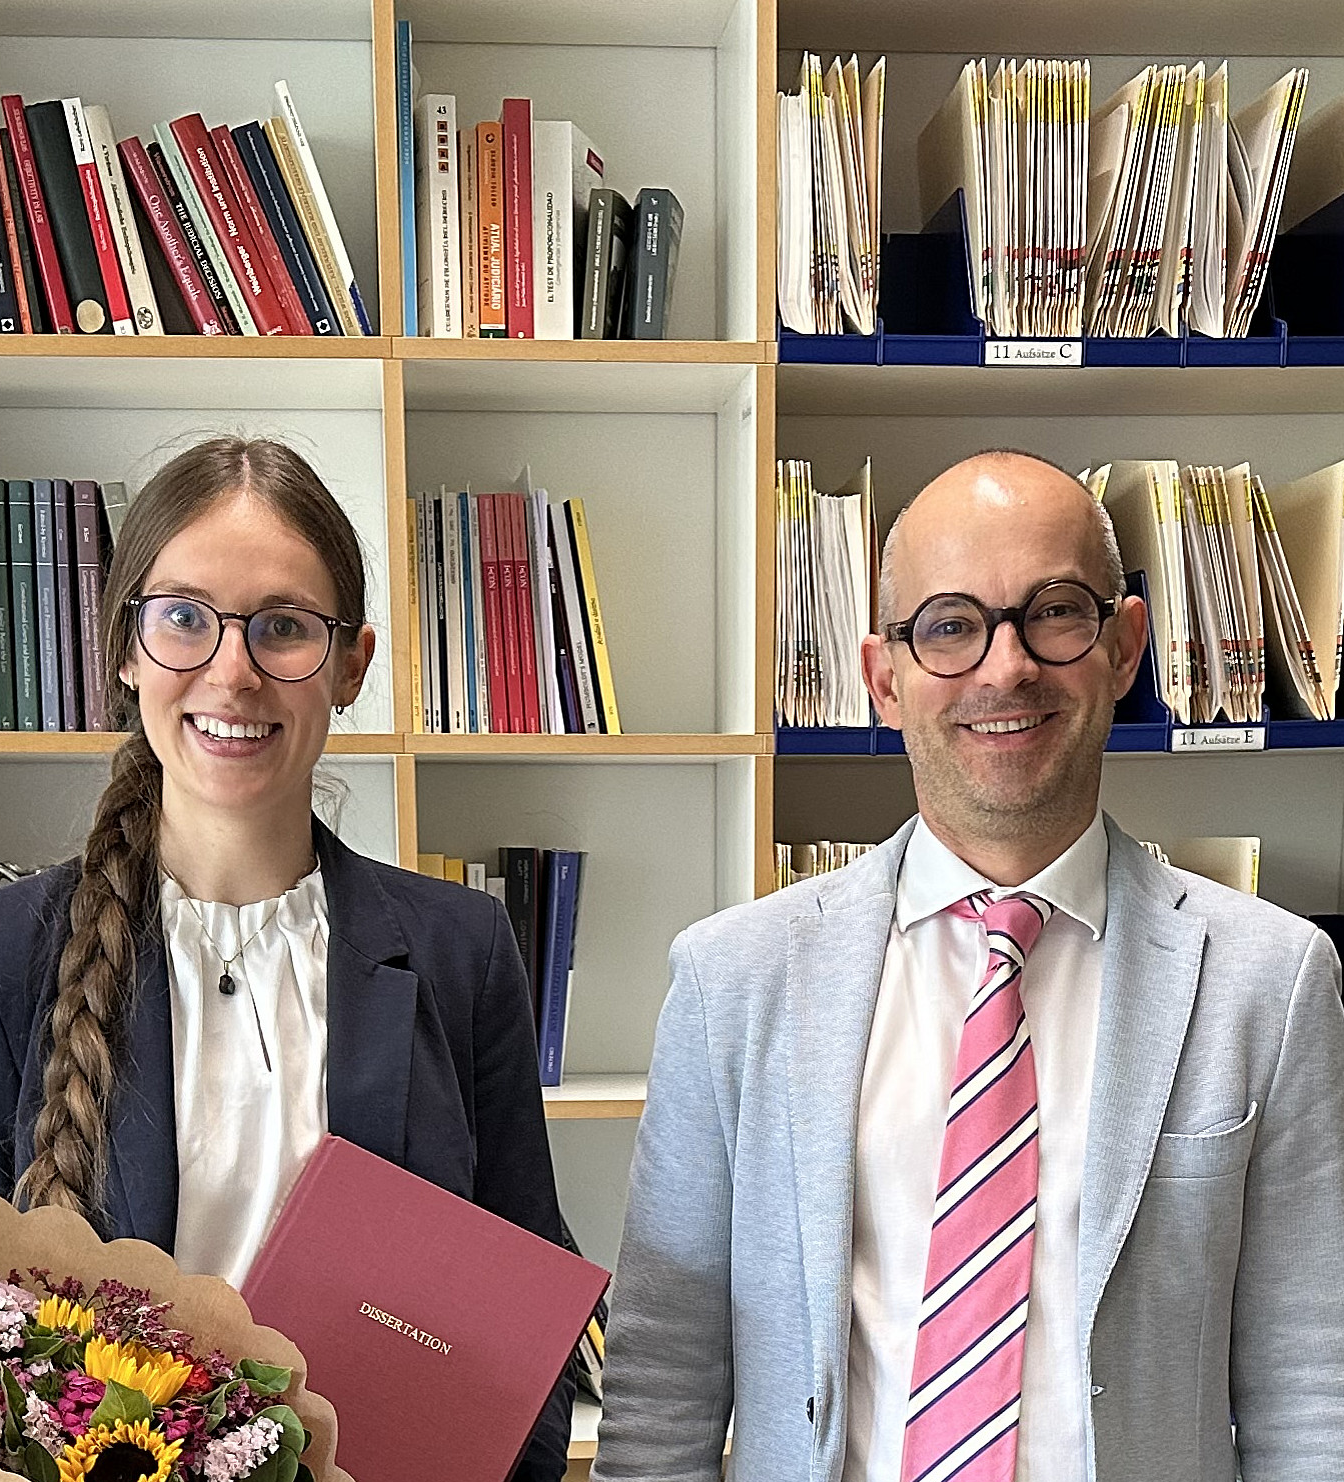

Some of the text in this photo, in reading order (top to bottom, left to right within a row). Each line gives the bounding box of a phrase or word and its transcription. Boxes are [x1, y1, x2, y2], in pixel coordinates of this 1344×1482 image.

[196, 147, 263, 295] Weinberger Norm und Institution
[148, 194, 200, 301] One Another's Equals
[175, 202, 222, 300] THE JUDICIAL DECISION
[490, 223, 500, 254] ATUAL
[546, 267, 554, 275] DE
[547, 294, 554, 303] EL
[994, 343, 1072, 359] 11 Aufsätze C
[1180, 729, 1254, 746] 11 Aufsätze E
[359, 1302, 453, 1355] DISSERTATION
